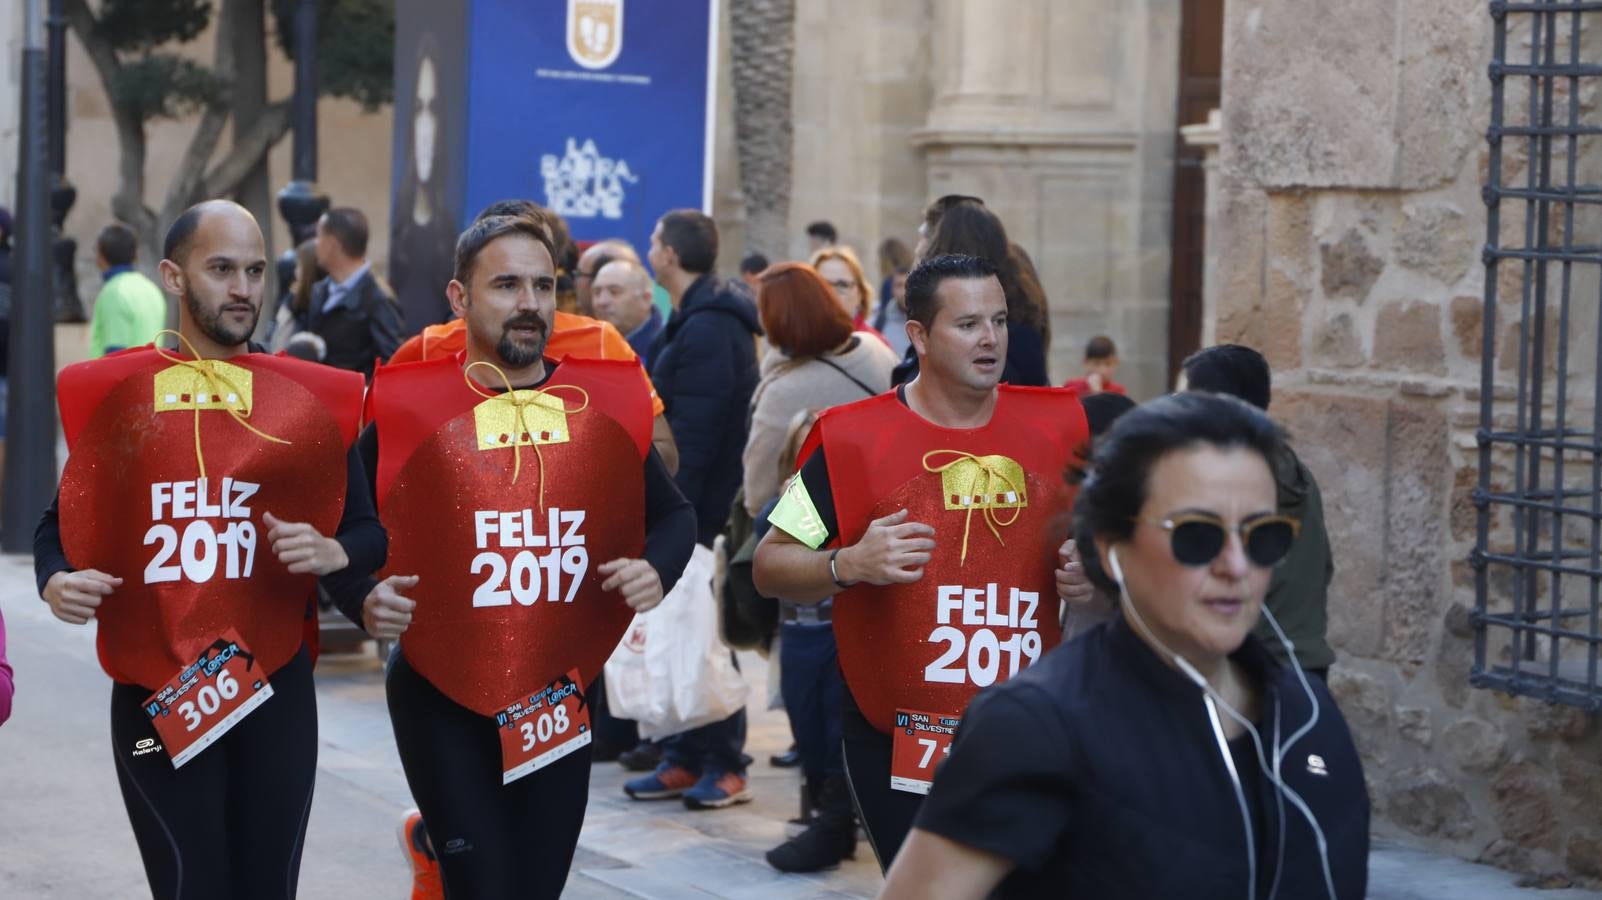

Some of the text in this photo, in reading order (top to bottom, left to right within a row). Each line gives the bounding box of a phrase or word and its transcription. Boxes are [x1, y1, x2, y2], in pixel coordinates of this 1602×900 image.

[151, 476, 260, 521] FELIZ
[474, 507, 586, 549] FELIZ
[143, 519, 257, 585] 2019
[470, 545, 589, 608] 2019
[936, 582, 1040, 629] FELIZ
[924, 625, 1042, 688] 2019
[156, 686, 175, 702] SAN
[177, 668, 240, 732] 306
[547, 683, 578, 706] LORCA
[146, 702, 161, 717] VI
[506, 702, 523, 714] SAN
[512, 700, 544, 721] SILVESTRE
[496, 713, 508, 727] VI
[520, 703, 570, 753] 308
[896, 713, 960, 727] VI SAN CIUDA
[914, 722, 955, 735] SILVESTRE
[132, 745, 163, 757] Kalenji
